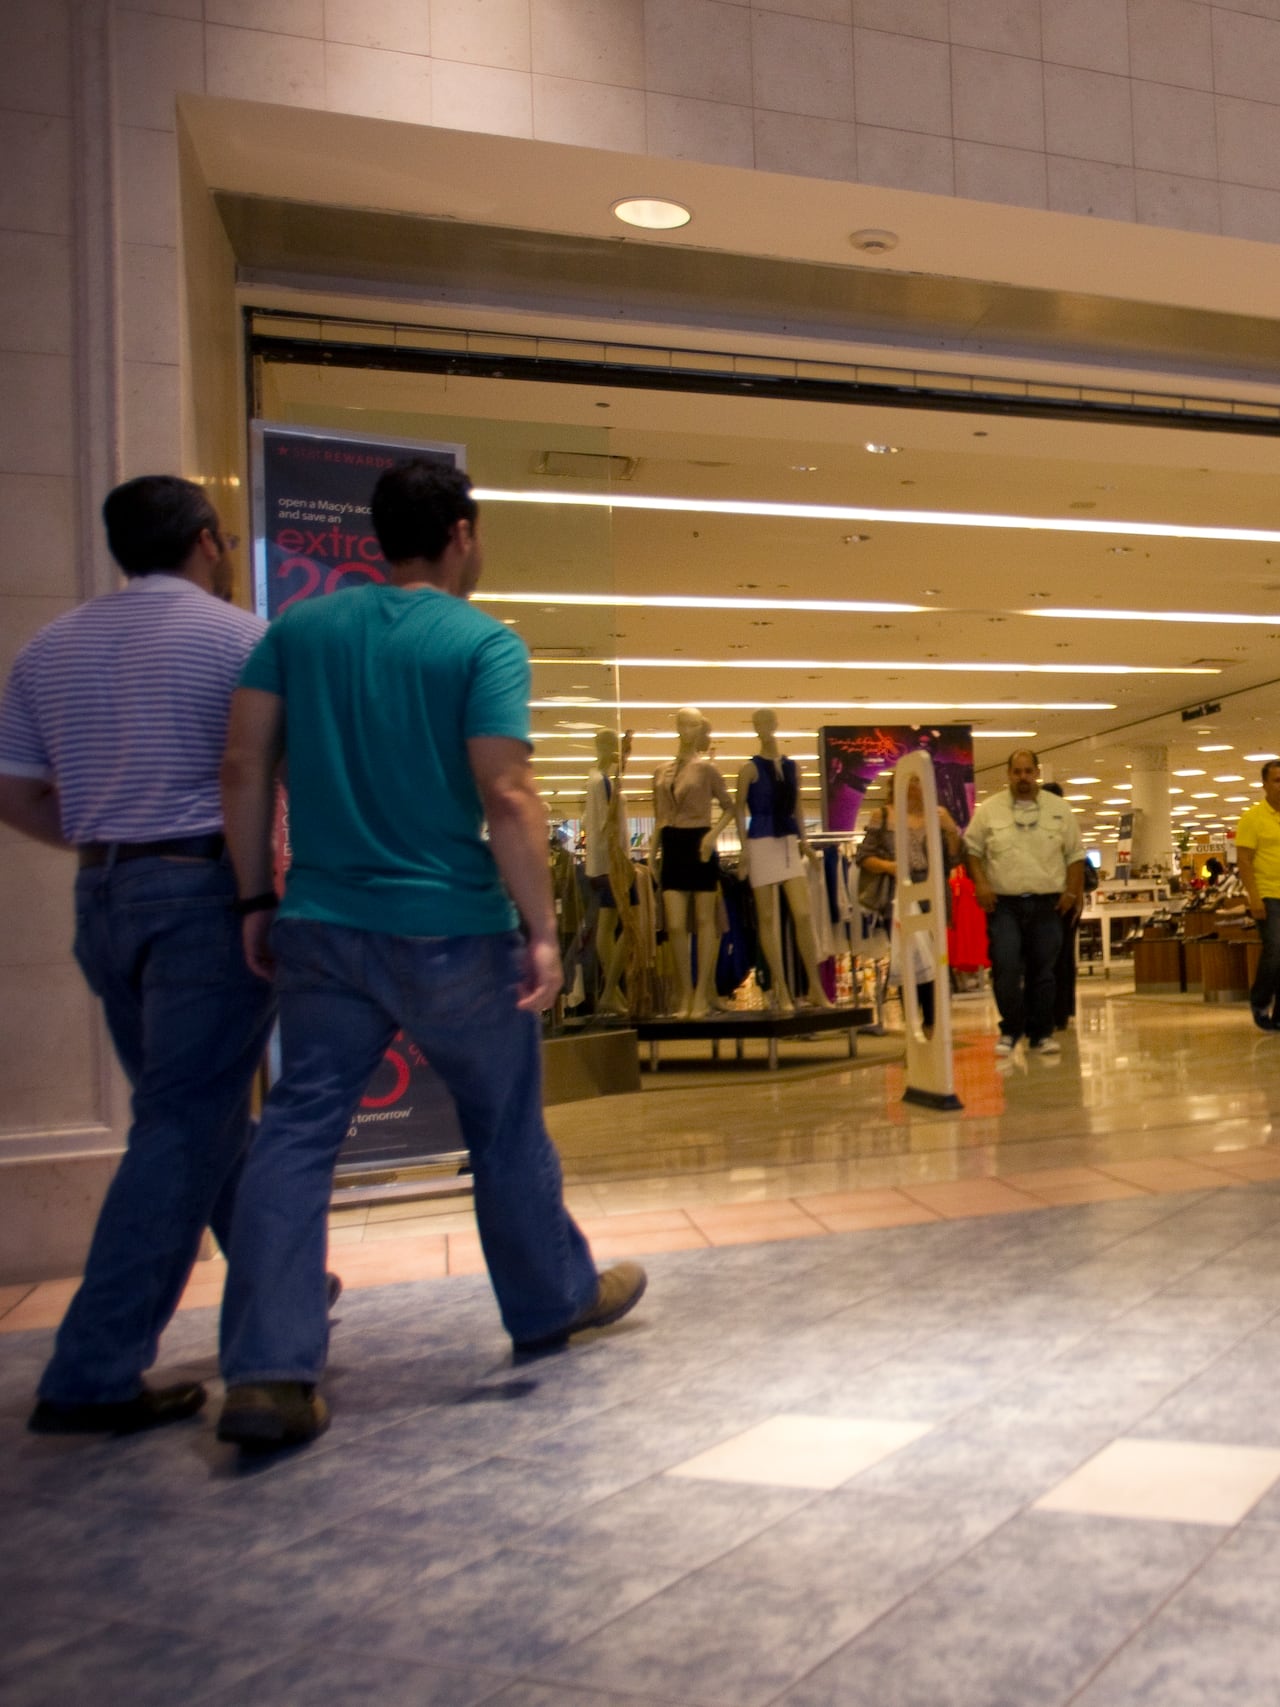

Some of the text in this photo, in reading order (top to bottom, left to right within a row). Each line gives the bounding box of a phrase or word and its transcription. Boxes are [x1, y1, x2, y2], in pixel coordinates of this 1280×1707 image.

[278, 498, 373, 515] open a Macy's acc
[278, 510, 342, 524] and save an
